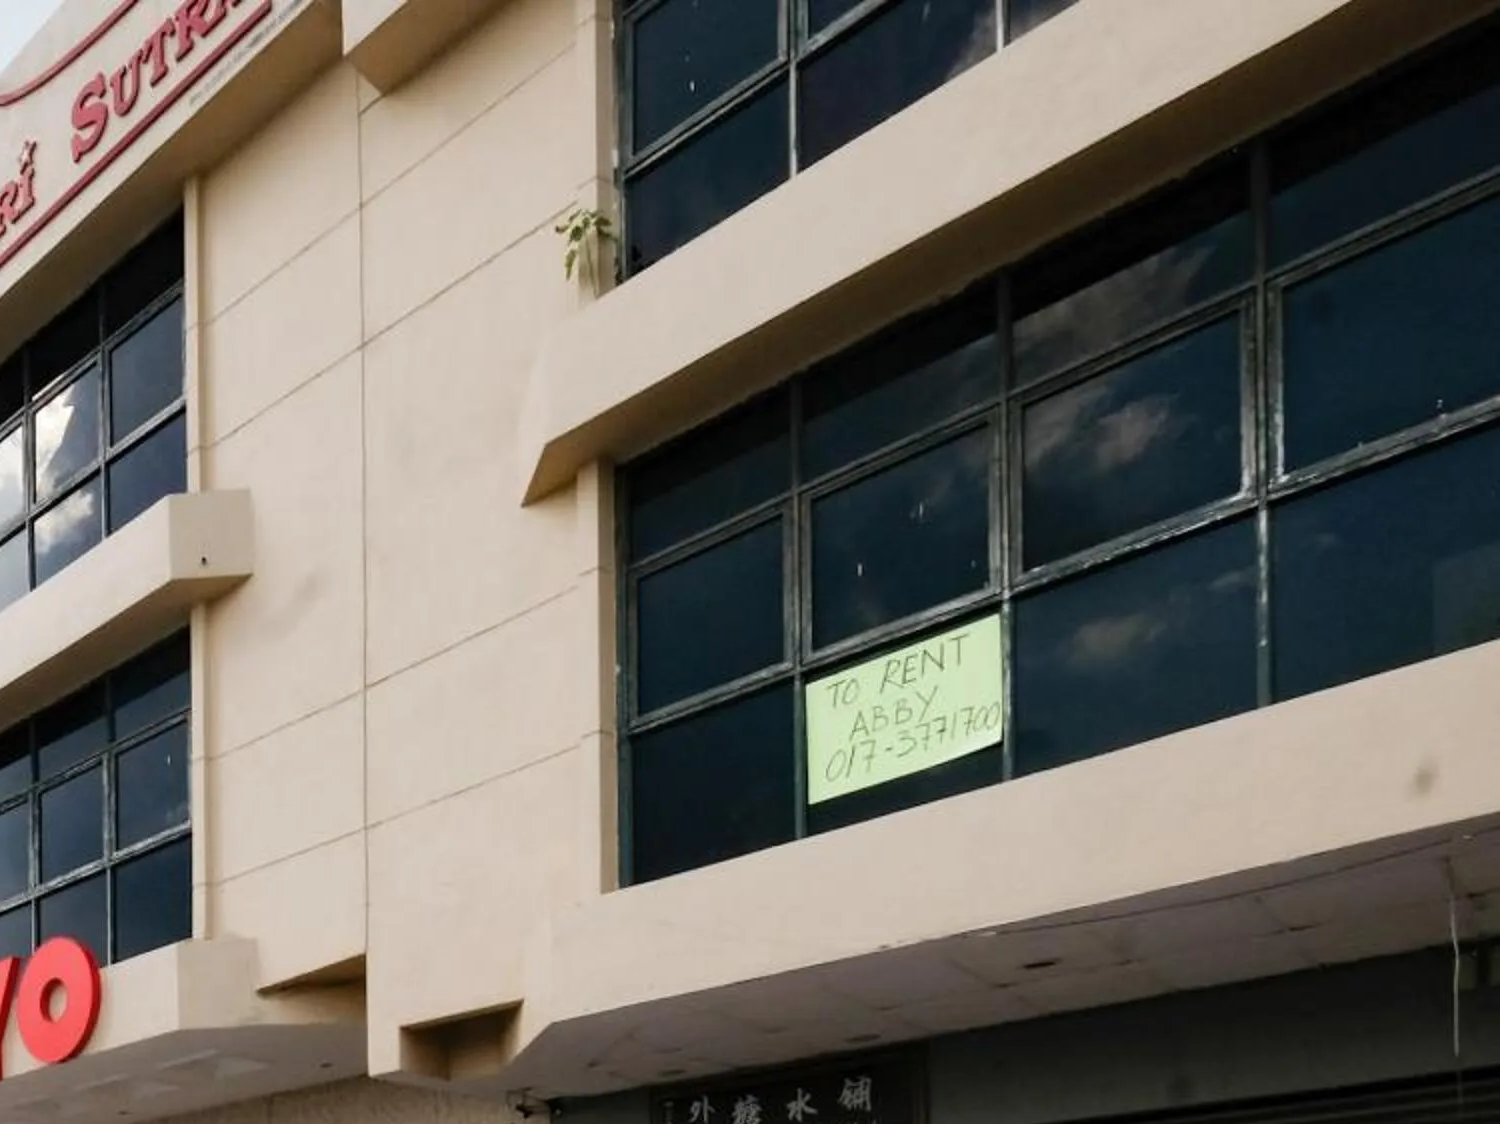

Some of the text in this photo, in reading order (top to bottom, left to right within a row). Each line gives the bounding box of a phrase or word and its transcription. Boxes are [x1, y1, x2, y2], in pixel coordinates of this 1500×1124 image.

[70, 0, 242, 164] SUTR
[826, 632, 970, 709] TO RENT
[849, 685, 939, 742] ABBY
